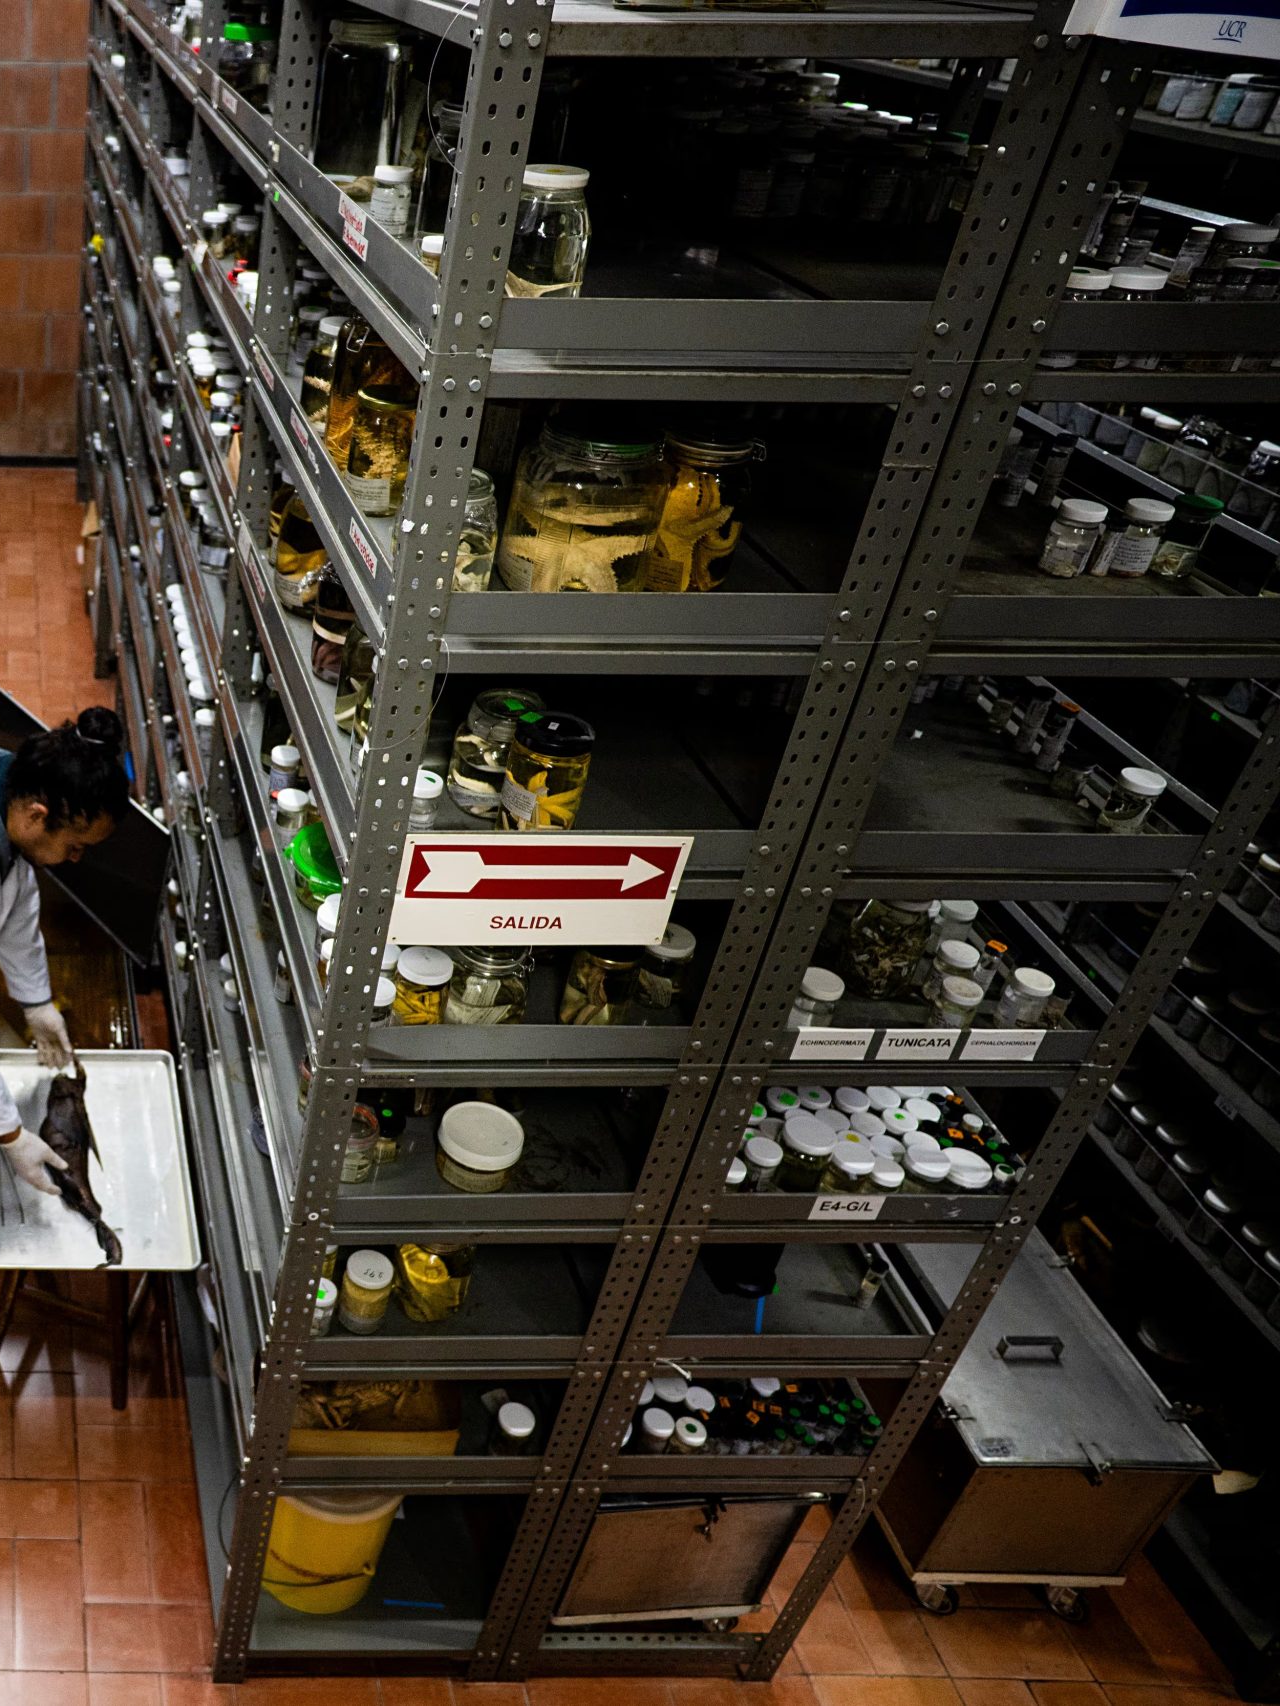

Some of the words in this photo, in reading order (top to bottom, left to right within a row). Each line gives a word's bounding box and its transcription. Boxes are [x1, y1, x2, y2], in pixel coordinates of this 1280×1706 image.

[1218, 19, 1247, 38] UCR
[489, 915, 562, 930] SALIDA
[887, 1037, 952, 1048] TUNICATA
[819, 1201, 873, 1212] E4-G/L
